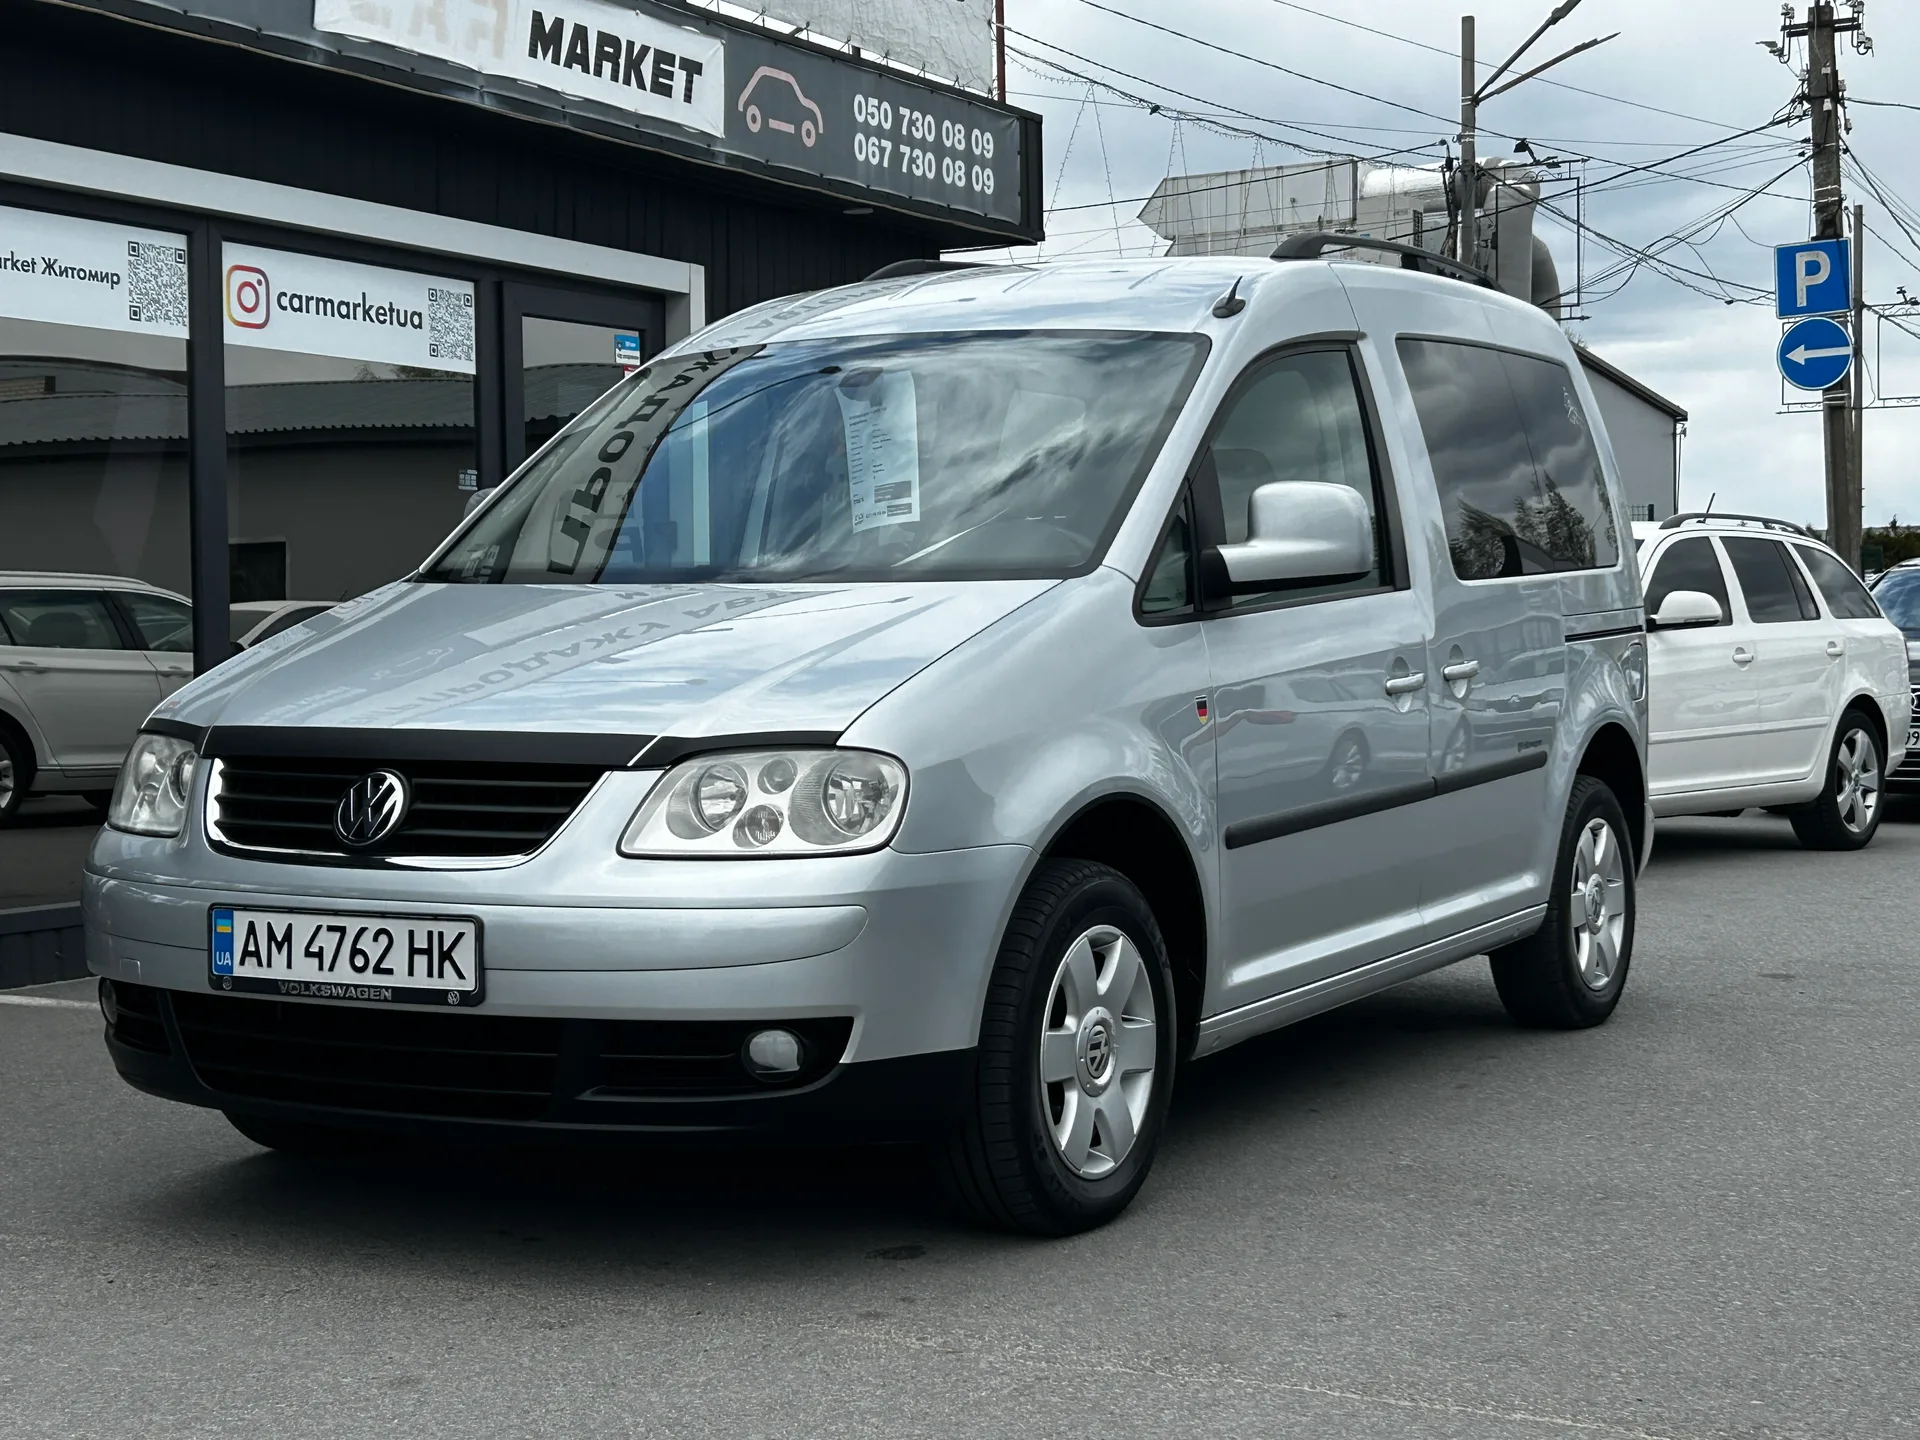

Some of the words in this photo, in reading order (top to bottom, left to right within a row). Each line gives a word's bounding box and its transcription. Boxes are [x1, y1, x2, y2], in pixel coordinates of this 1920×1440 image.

[528, 9, 704, 104] MARKET
[853, 94, 892, 130] 050
[899, 106, 936, 142] 730
[942, 119, 966, 151] 08
[971, 128, 994, 159] 09
[854, 132, 892, 168] 067
[900, 144, 936, 180] 730
[942, 156, 966, 187] 08
[971, 165, 995, 195] 09
[0, 250, 37, 274] rket
[41, 256, 121, 290] Житомир
[1795, 250, 1831, 307] P
[276, 291, 423, 330] carmarketua
[216, 951, 232, 967] UA
[239, 920, 293, 969] AM
[304, 924, 394, 975] 4762
[408, 929, 467, 980] HK
[278, 981, 392, 1000] VOLKSWAGEN
